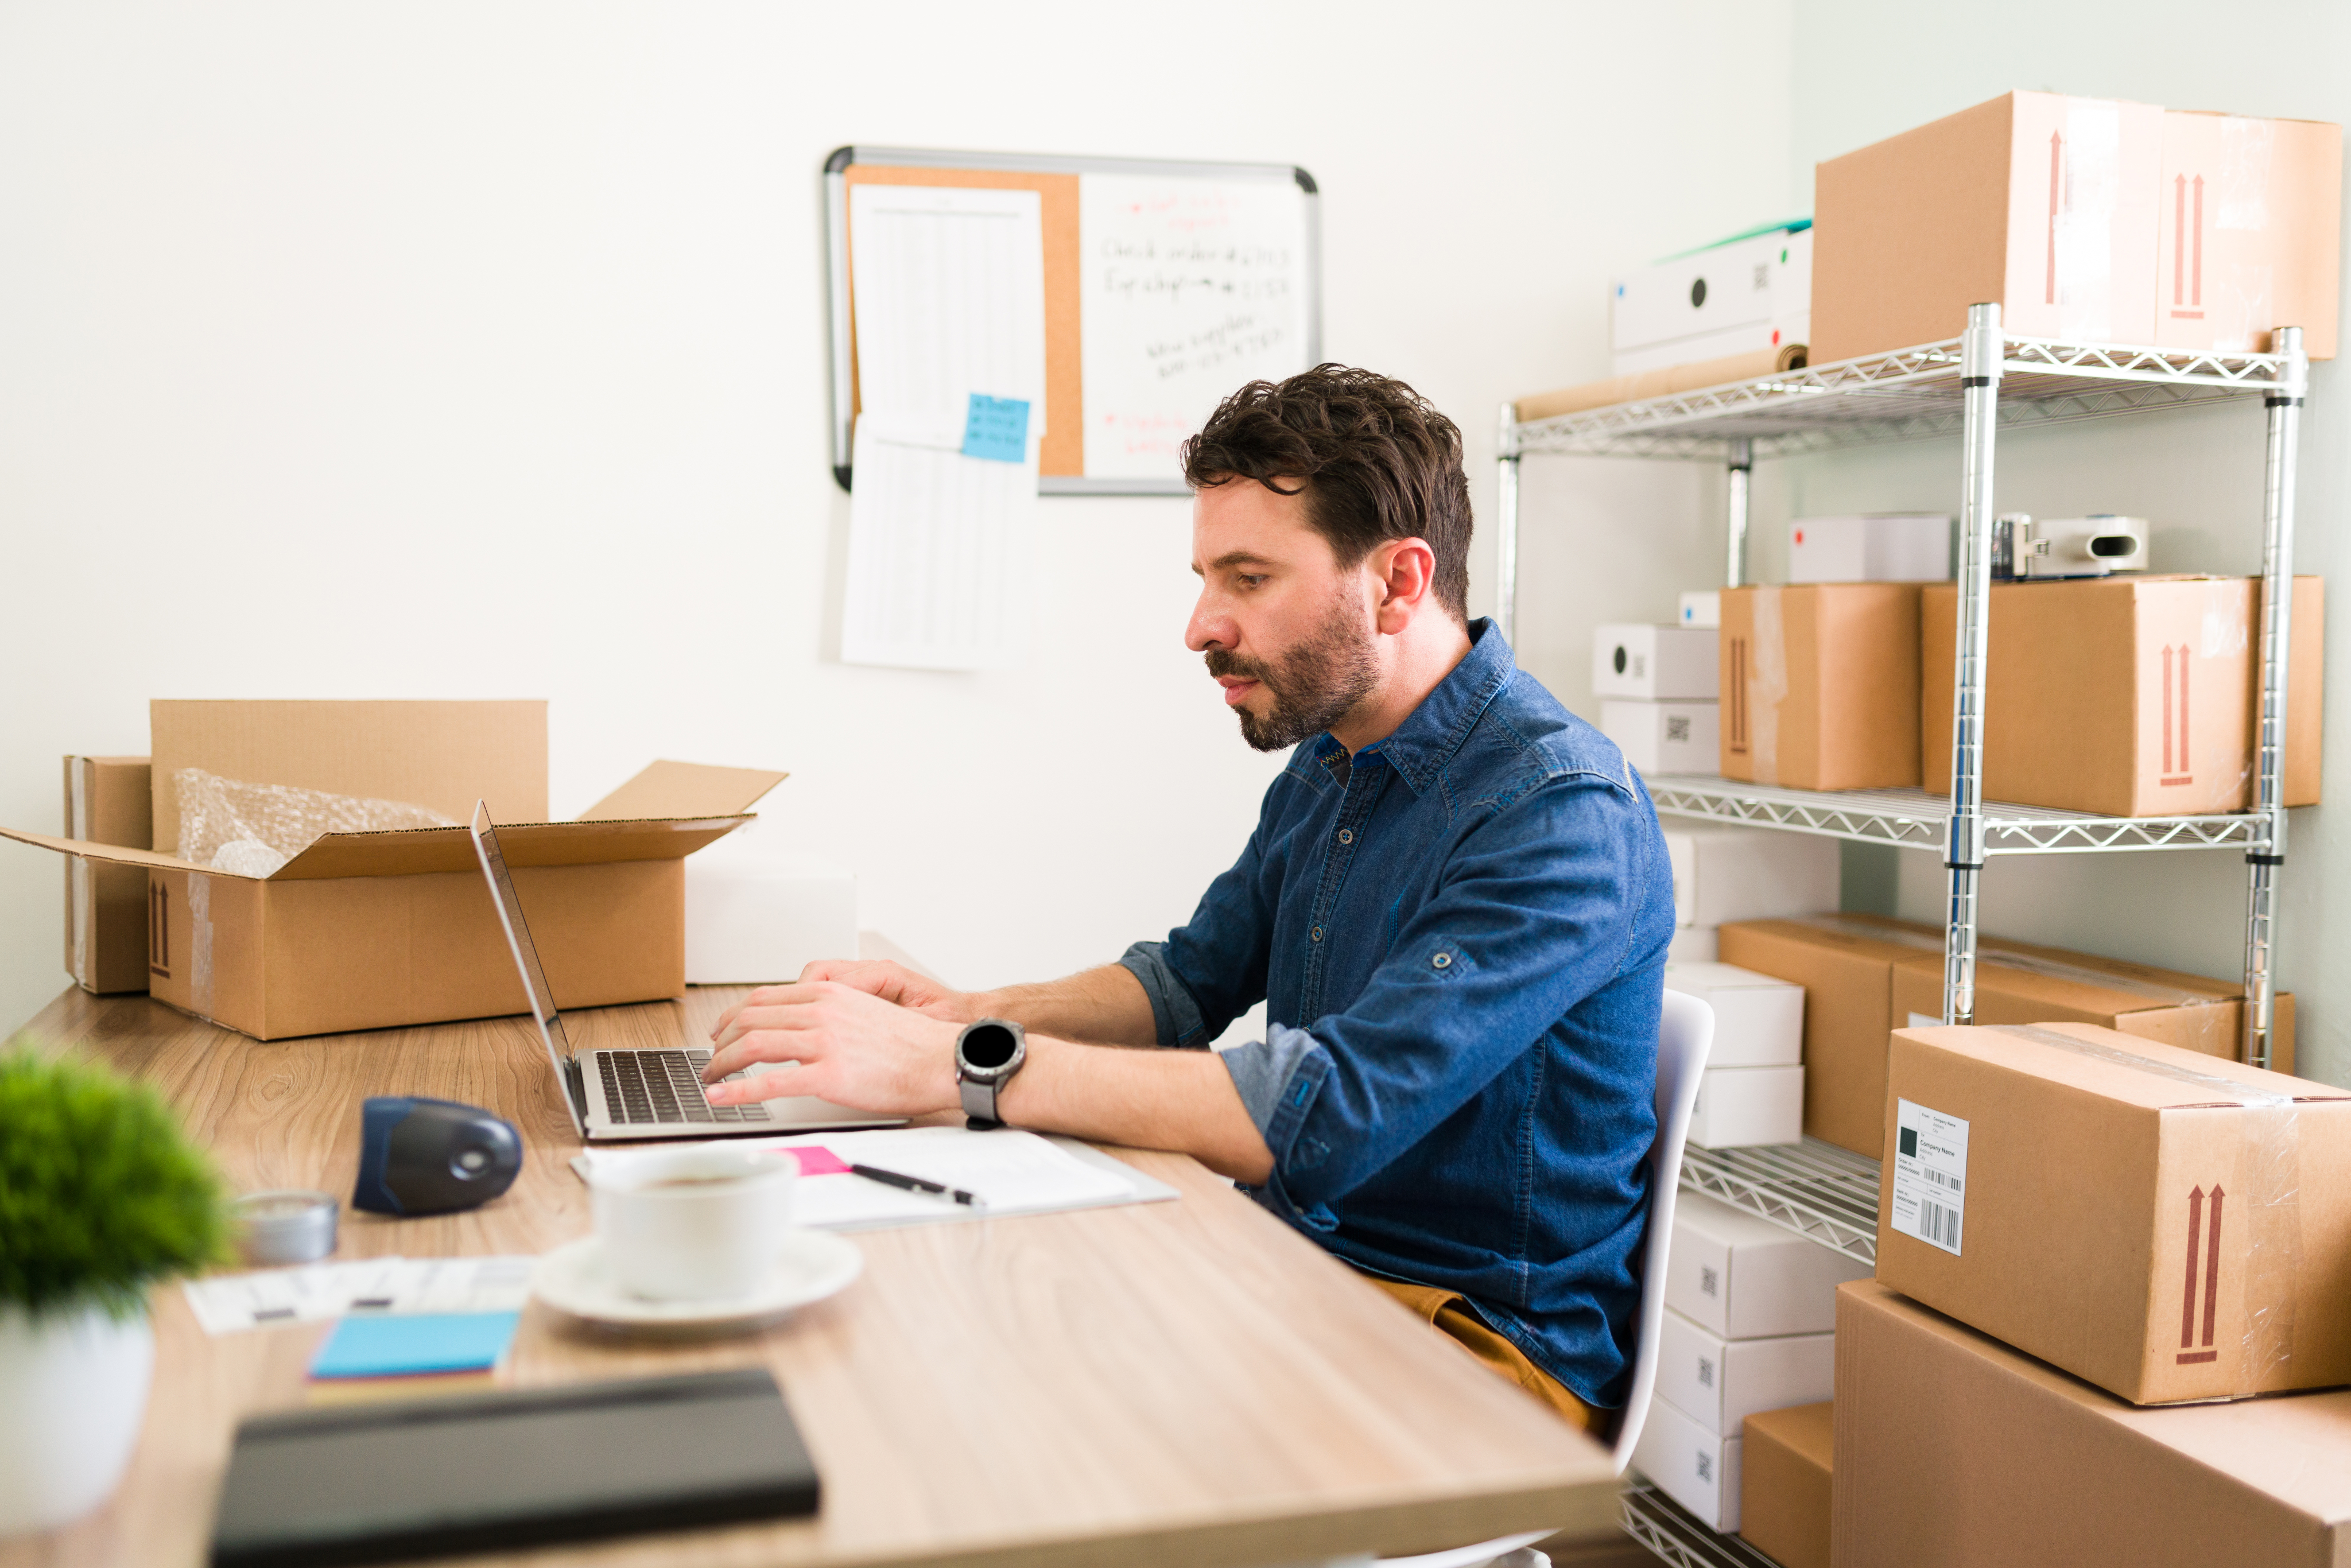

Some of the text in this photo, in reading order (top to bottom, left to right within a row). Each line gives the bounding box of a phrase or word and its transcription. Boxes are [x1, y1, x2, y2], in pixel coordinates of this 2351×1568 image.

[1933, 1116, 1947, 1125] Company
[1920, 1139, 1955, 1157] Company Name
